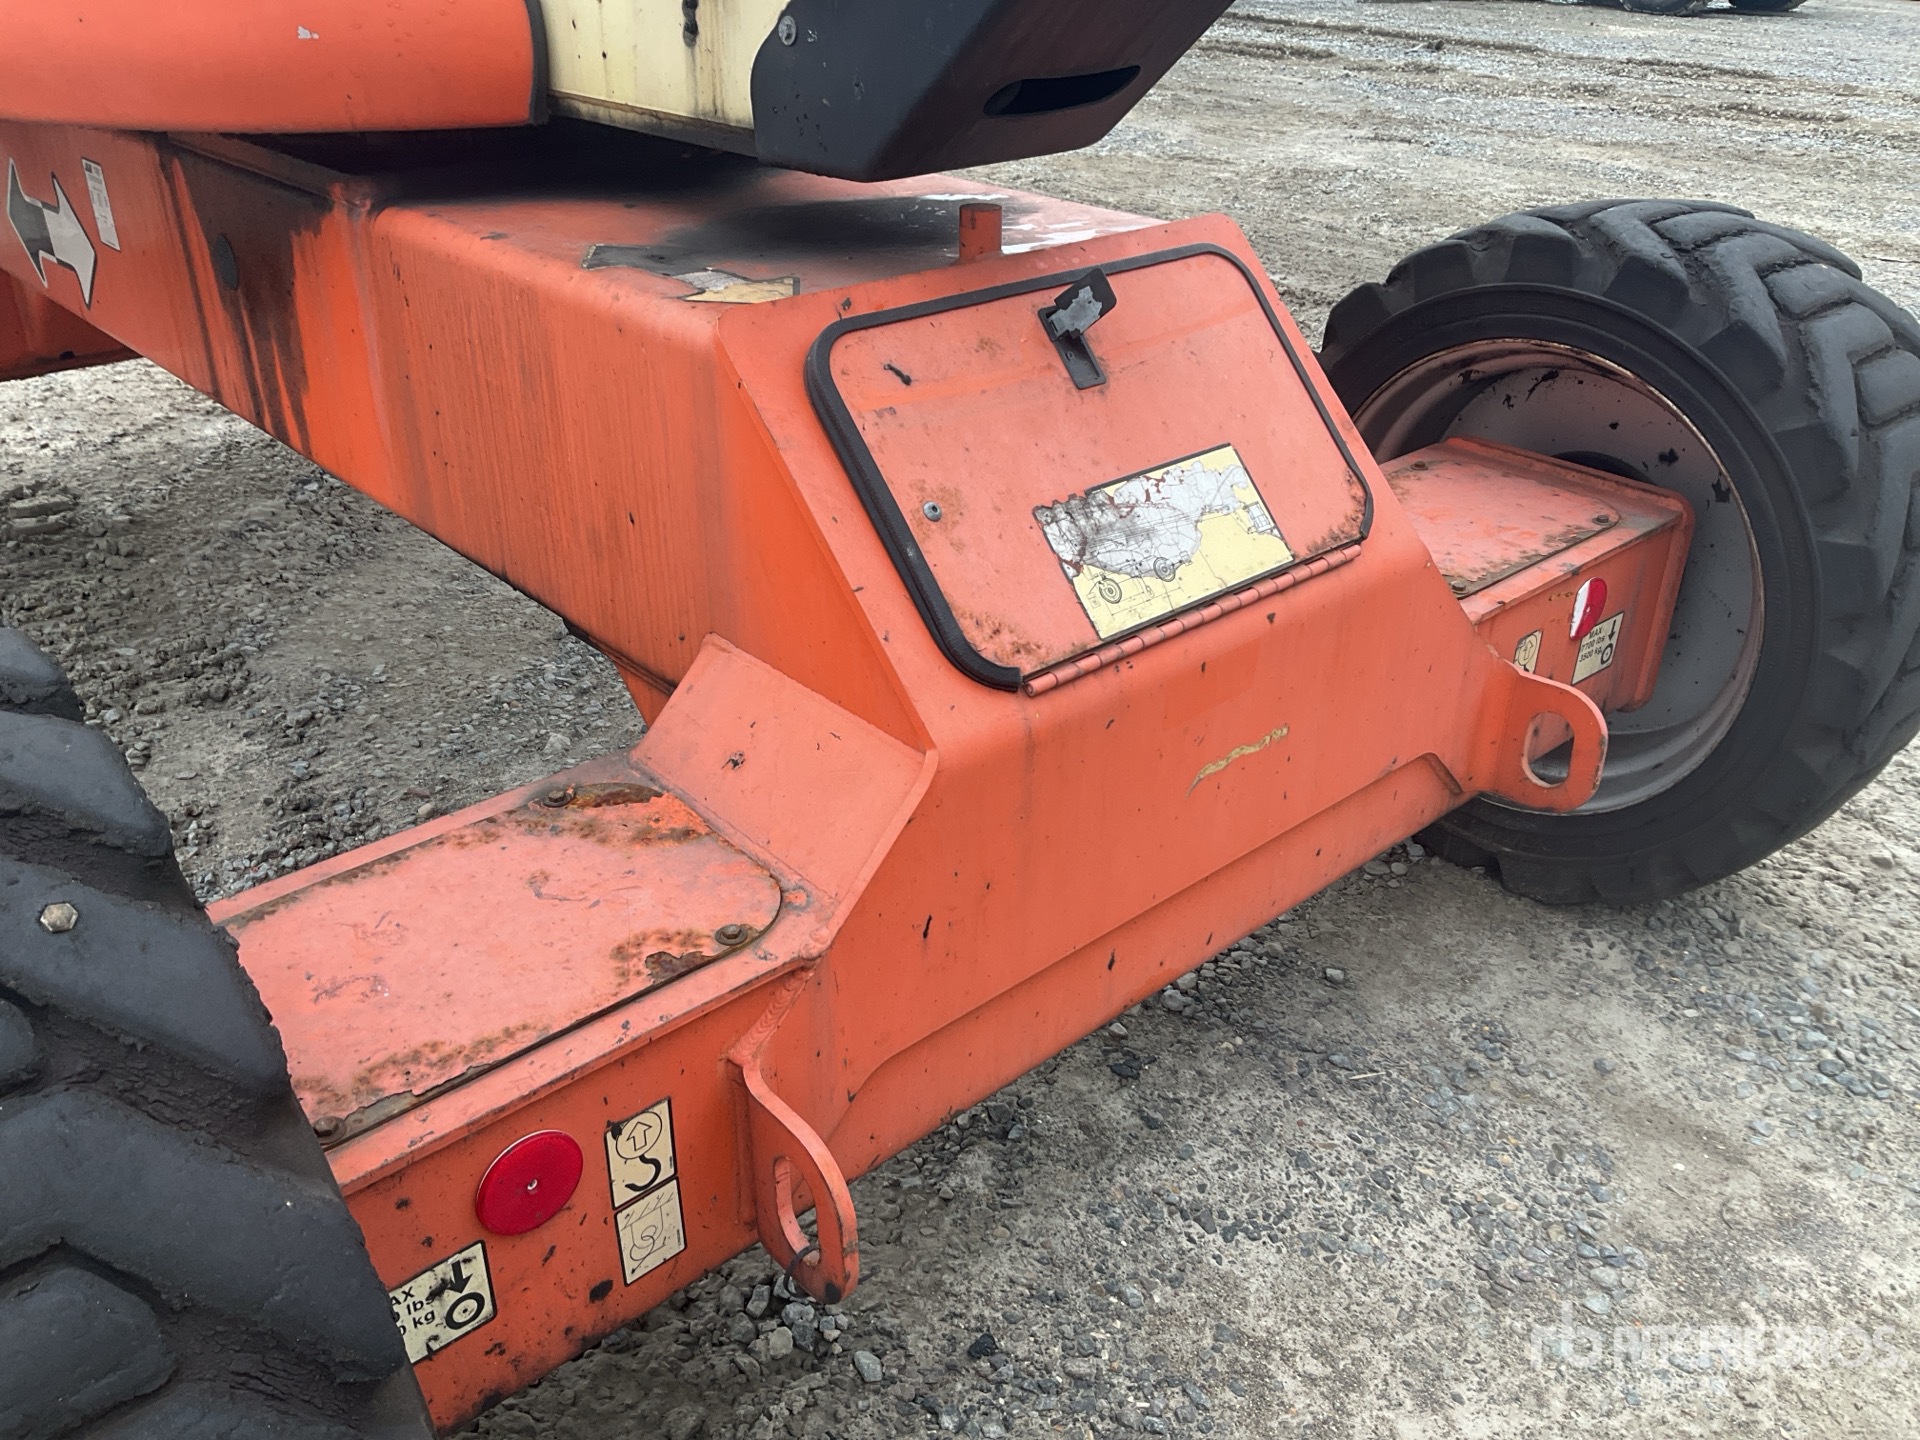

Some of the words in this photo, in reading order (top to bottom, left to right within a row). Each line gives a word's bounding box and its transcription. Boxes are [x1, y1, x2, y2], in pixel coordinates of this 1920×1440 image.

[1589, 628, 1603, 639] MAX
[1581, 639, 1595, 652] 7700
[1595, 635, 1605, 645] lbs
[1579, 650, 1594, 663] 3500
[391, 1286, 415, 1307] AX
[406, 1295, 436, 1316] lbs
[412, 1310, 436, 1330] kg
